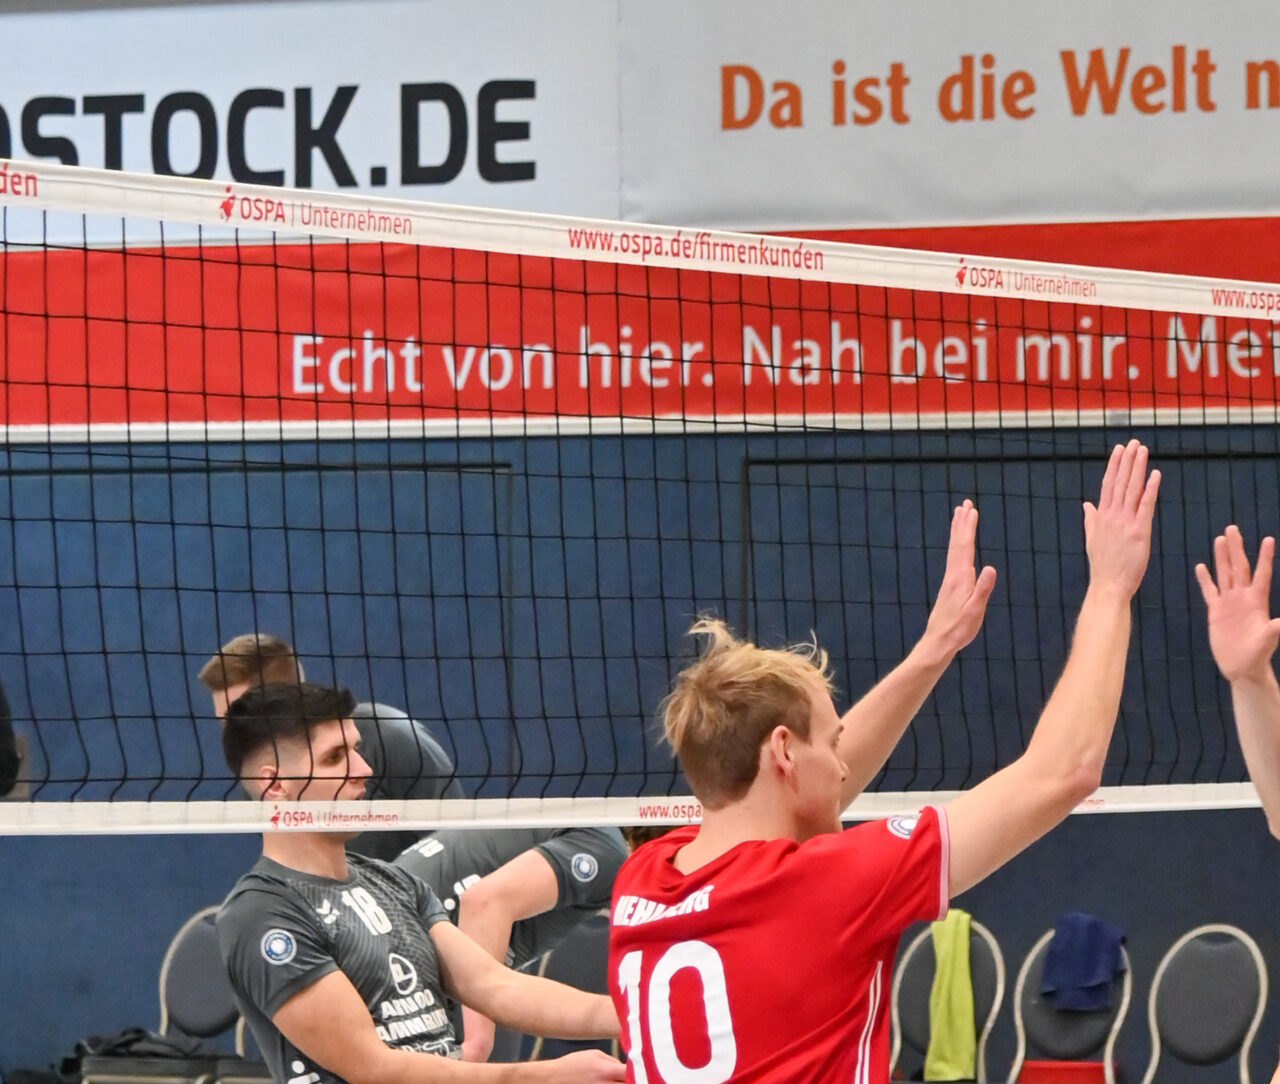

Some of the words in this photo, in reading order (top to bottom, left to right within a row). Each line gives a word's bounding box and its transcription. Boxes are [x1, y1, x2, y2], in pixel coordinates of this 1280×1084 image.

[720, 63, 803, 130] Da
[832, 59, 911, 126] ist
[937, 54, 1037, 122] die
[1060, 44, 1217, 116] Welt
[0, 80, 537, 189] STOCK.DE
[240, 197, 286, 224] OSPA
[301, 203, 413, 235] Unternehmen
[568, 227, 825, 270] www.ospa.de/firmenkunden
[969, 267, 1004, 289] OSPA
[1014, 271, 1097, 297] Unternehmen
[293, 329, 425, 394] Echt
[442, 344, 555, 391] von
[580, 324, 715, 388] hier.
[742, 320, 864, 387] Nah
[890, 318, 990, 385] bei
[1016, 315, 1141, 382] mir.
[282, 811, 314, 828] OSPA
[324, 811, 399, 828] Unternehmen
[341, 886, 393, 937] 18
